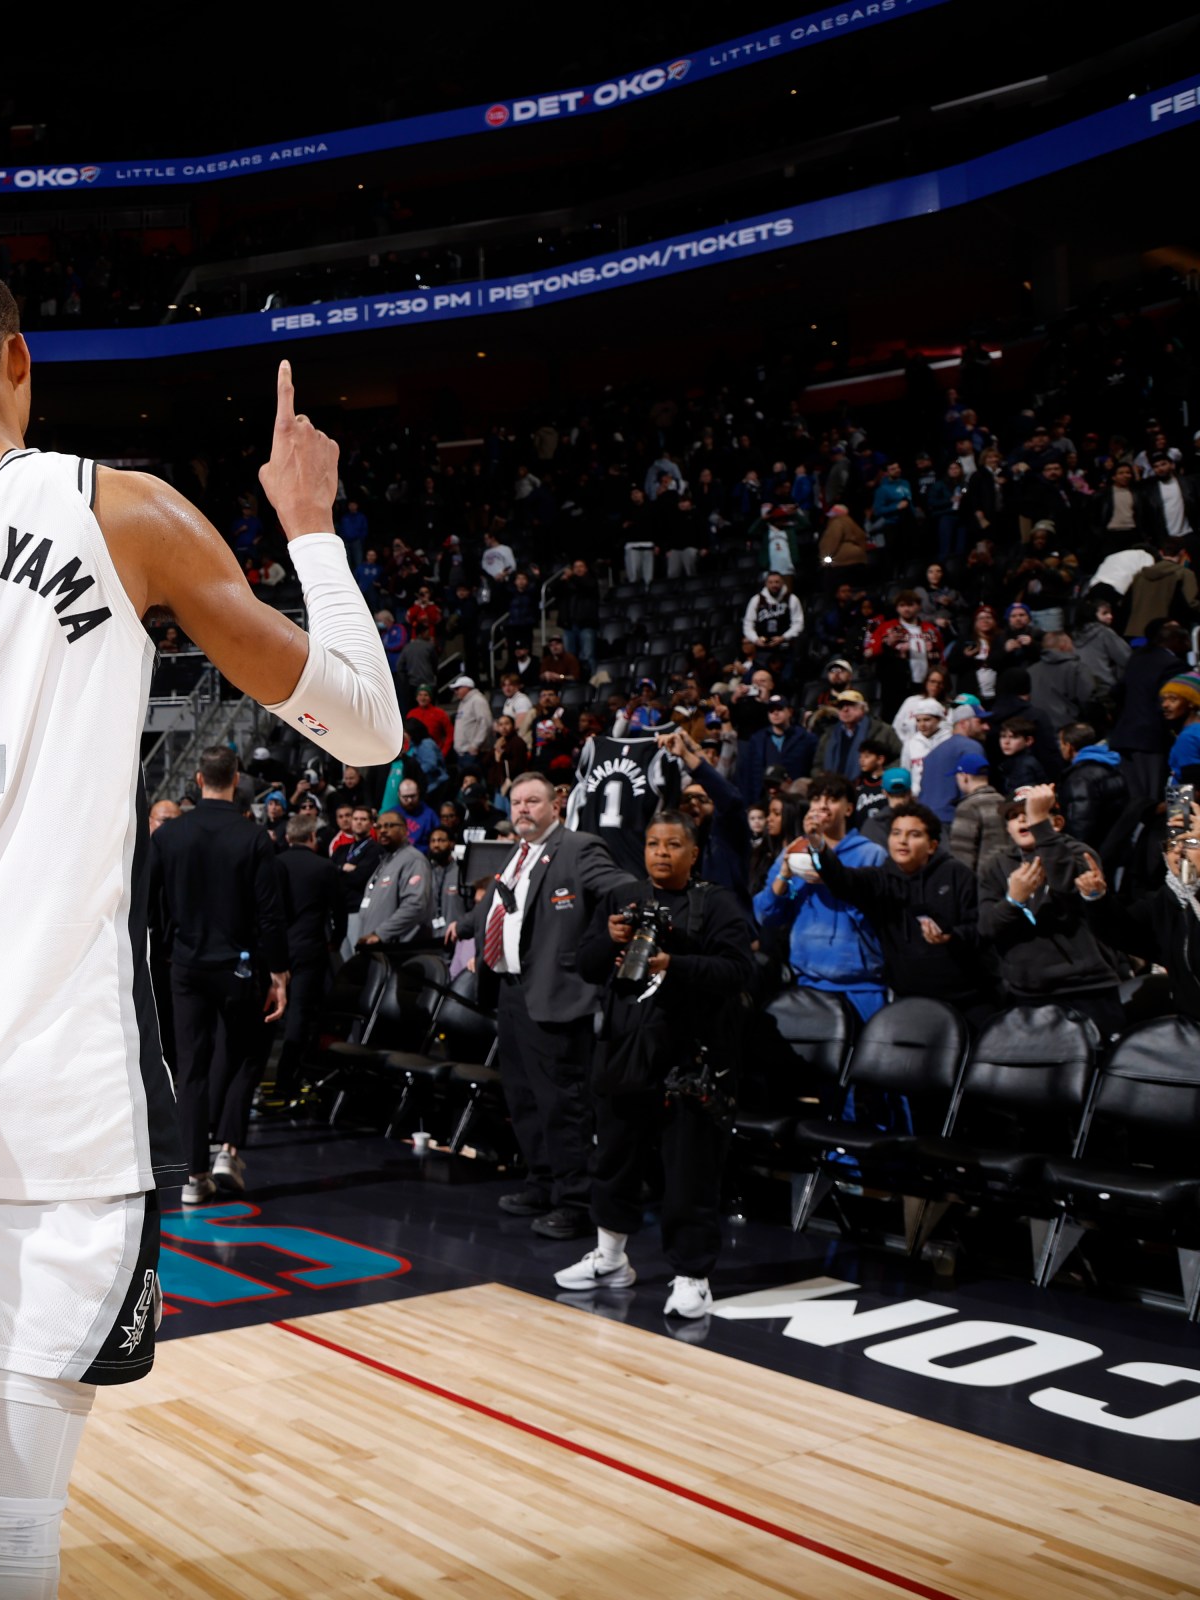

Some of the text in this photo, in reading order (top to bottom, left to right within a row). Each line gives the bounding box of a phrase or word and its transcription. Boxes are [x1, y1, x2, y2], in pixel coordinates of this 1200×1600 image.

[709, 0, 896, 66] LITTLE CAESARS
[513, 90, 585, 122] DET
[593, 67, 667, 106] OKC
[1150, 86, 1200, 122] FE
[14, 167, 78, 188] OKC
[116, 166, 175, 179] LITTLE
[182, 154, 263, 176] CAESARS
[269, 142, 328, 161] ARENA
[271, 218, 794, 332] FEB. 25 7:30 PM PISTONS.COM/TICKETS
[587, 757, 647, 797] WEMBANYAMA
[599, 780, 623, 828] 1
